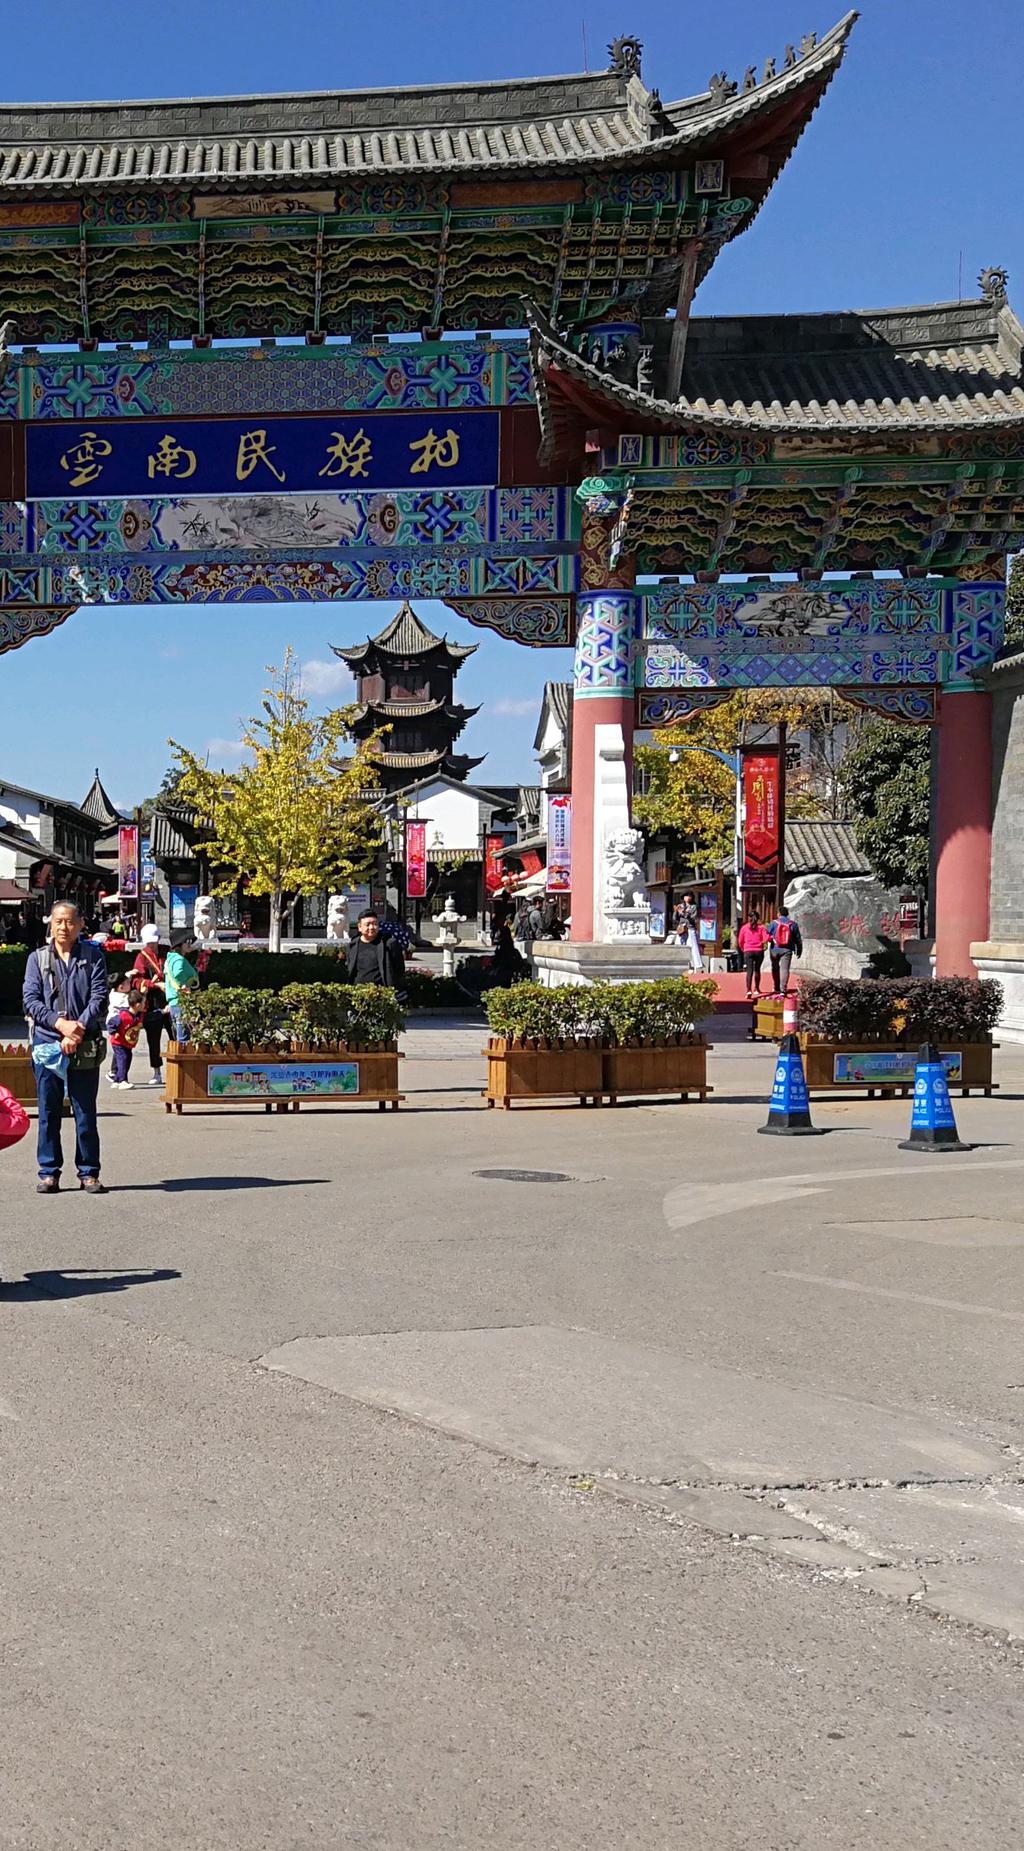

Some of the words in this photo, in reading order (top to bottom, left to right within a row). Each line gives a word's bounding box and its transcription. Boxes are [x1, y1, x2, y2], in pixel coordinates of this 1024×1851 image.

[60, 428, 459, 486] 雲南民族村
